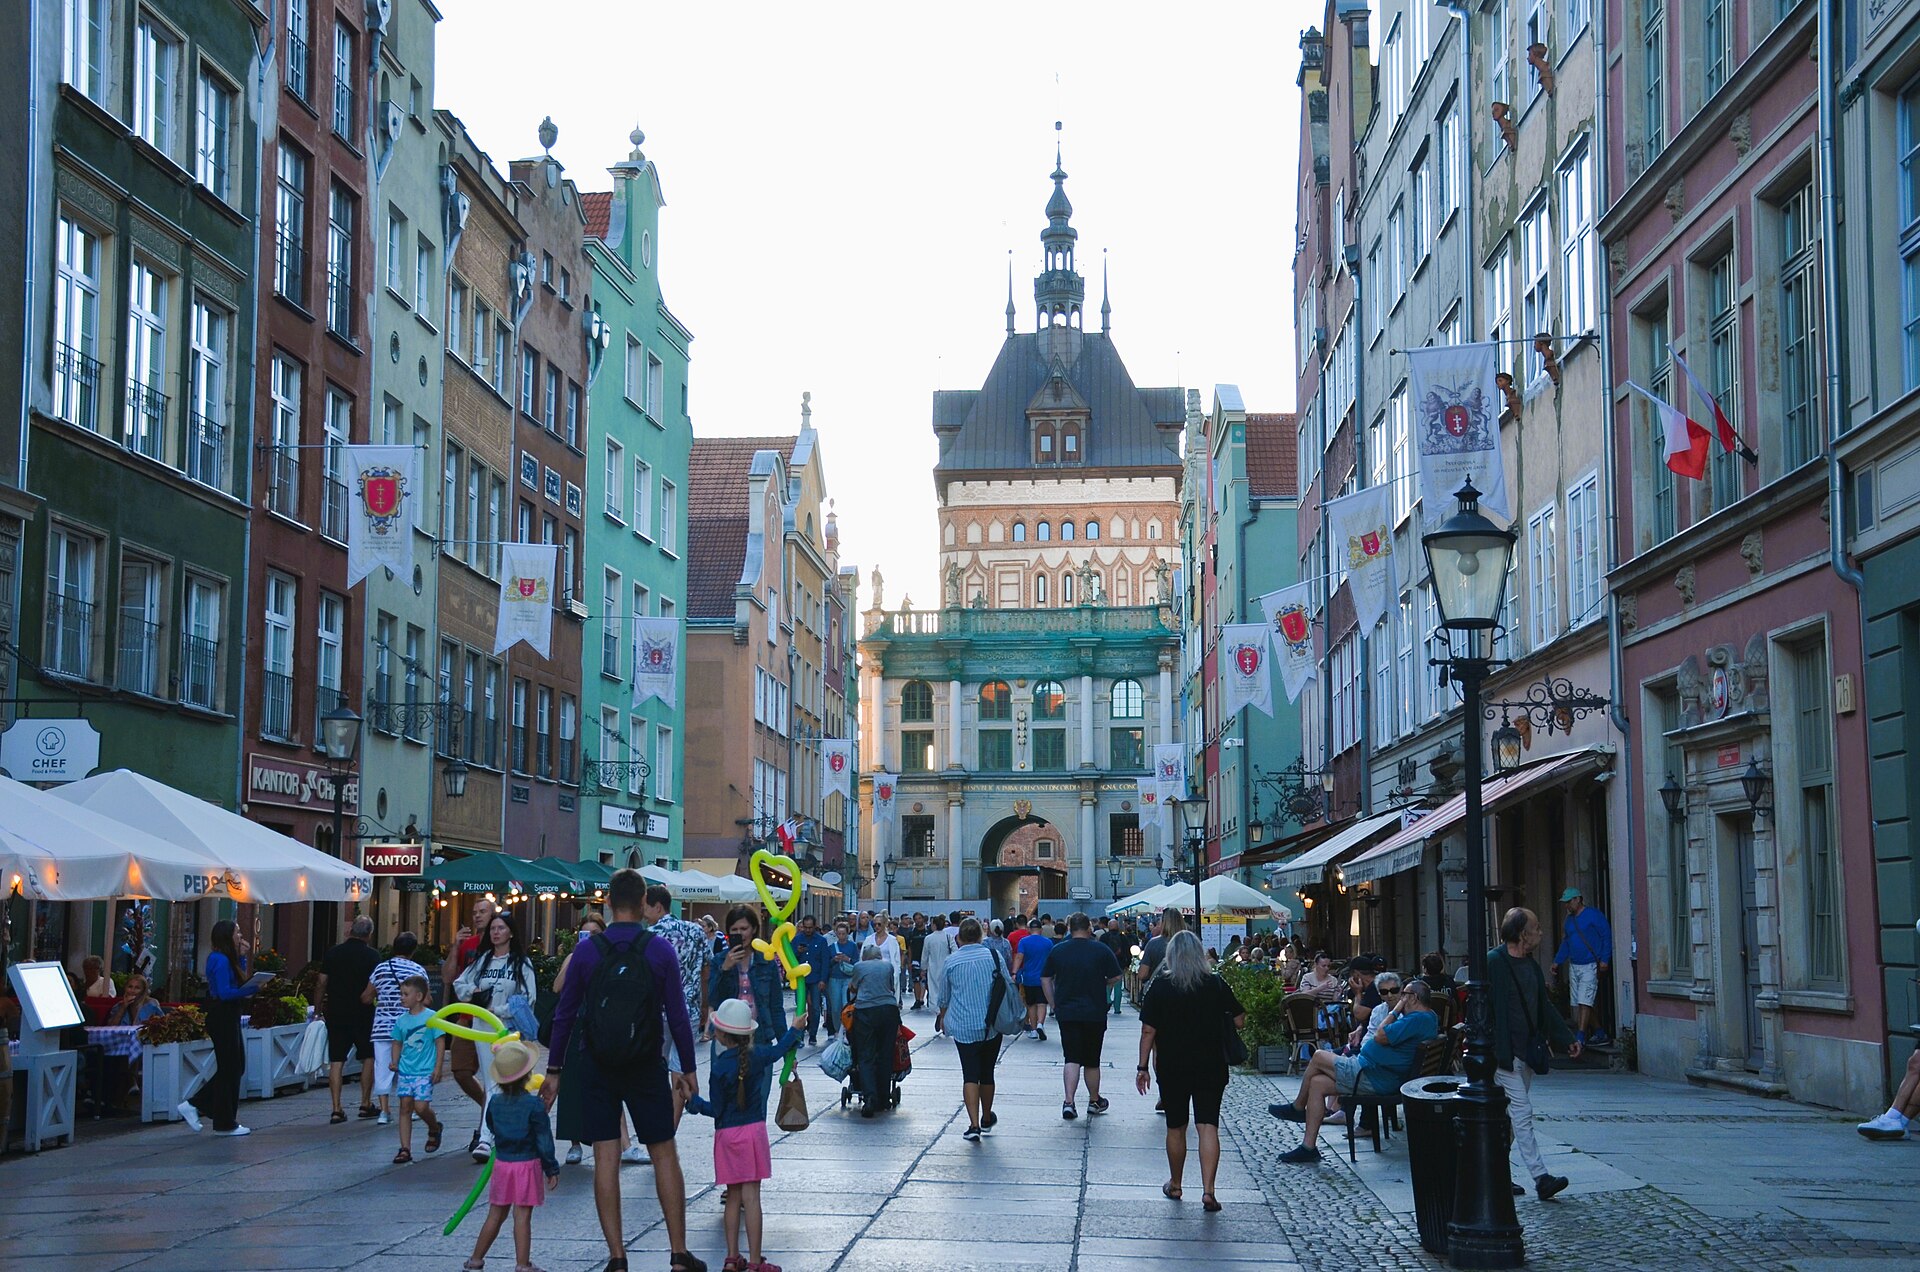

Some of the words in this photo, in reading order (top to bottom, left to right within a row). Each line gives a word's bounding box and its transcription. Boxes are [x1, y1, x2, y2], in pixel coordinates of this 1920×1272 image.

[1837, 676, 1849, 708] 76
[32, 759, 67, 768] CHEF
[252, 767, 300, 795] KANTOR
[366, 855, 419, 866] KANTOR
[463, 882, 494, 890] PERONI
[534, 884, 559, 892] Sempre
